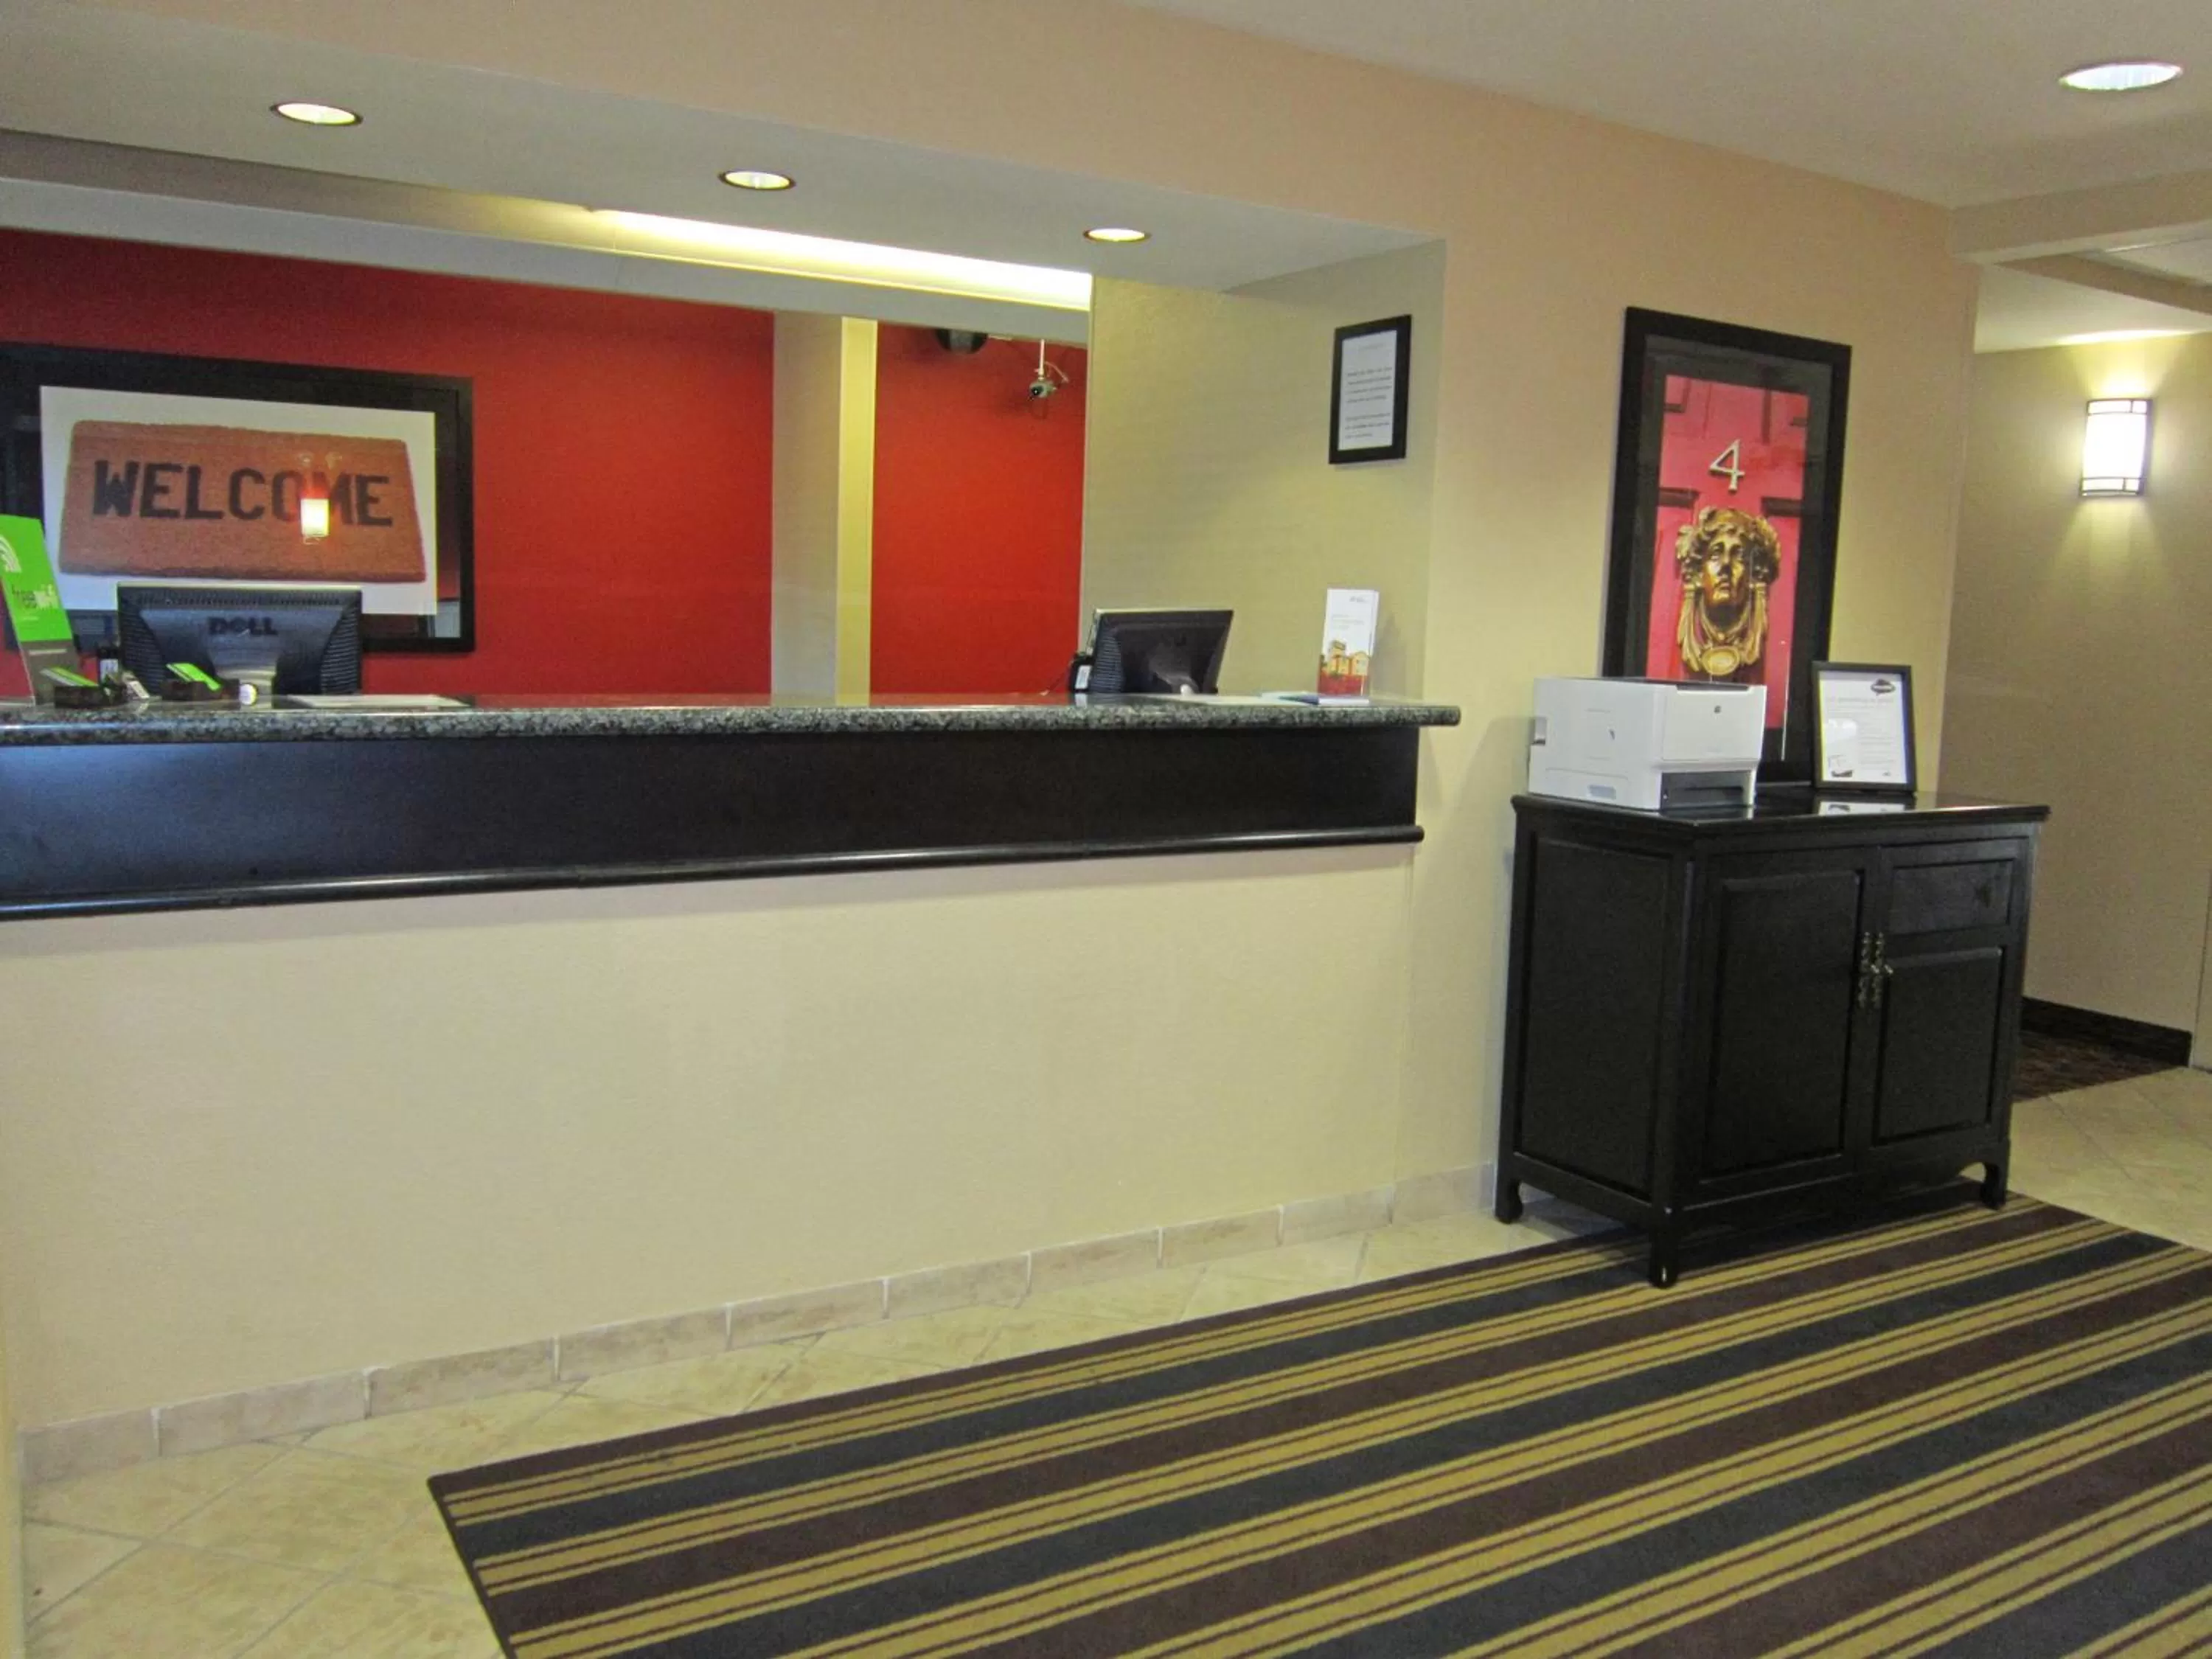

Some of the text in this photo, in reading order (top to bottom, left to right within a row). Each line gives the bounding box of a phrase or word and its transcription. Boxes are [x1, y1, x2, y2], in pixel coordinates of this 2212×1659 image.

[1709, 439, 1745, 492] 4
[93, 459, 393, 526] WELCOME
[209, 616, 278, 636] DELL
